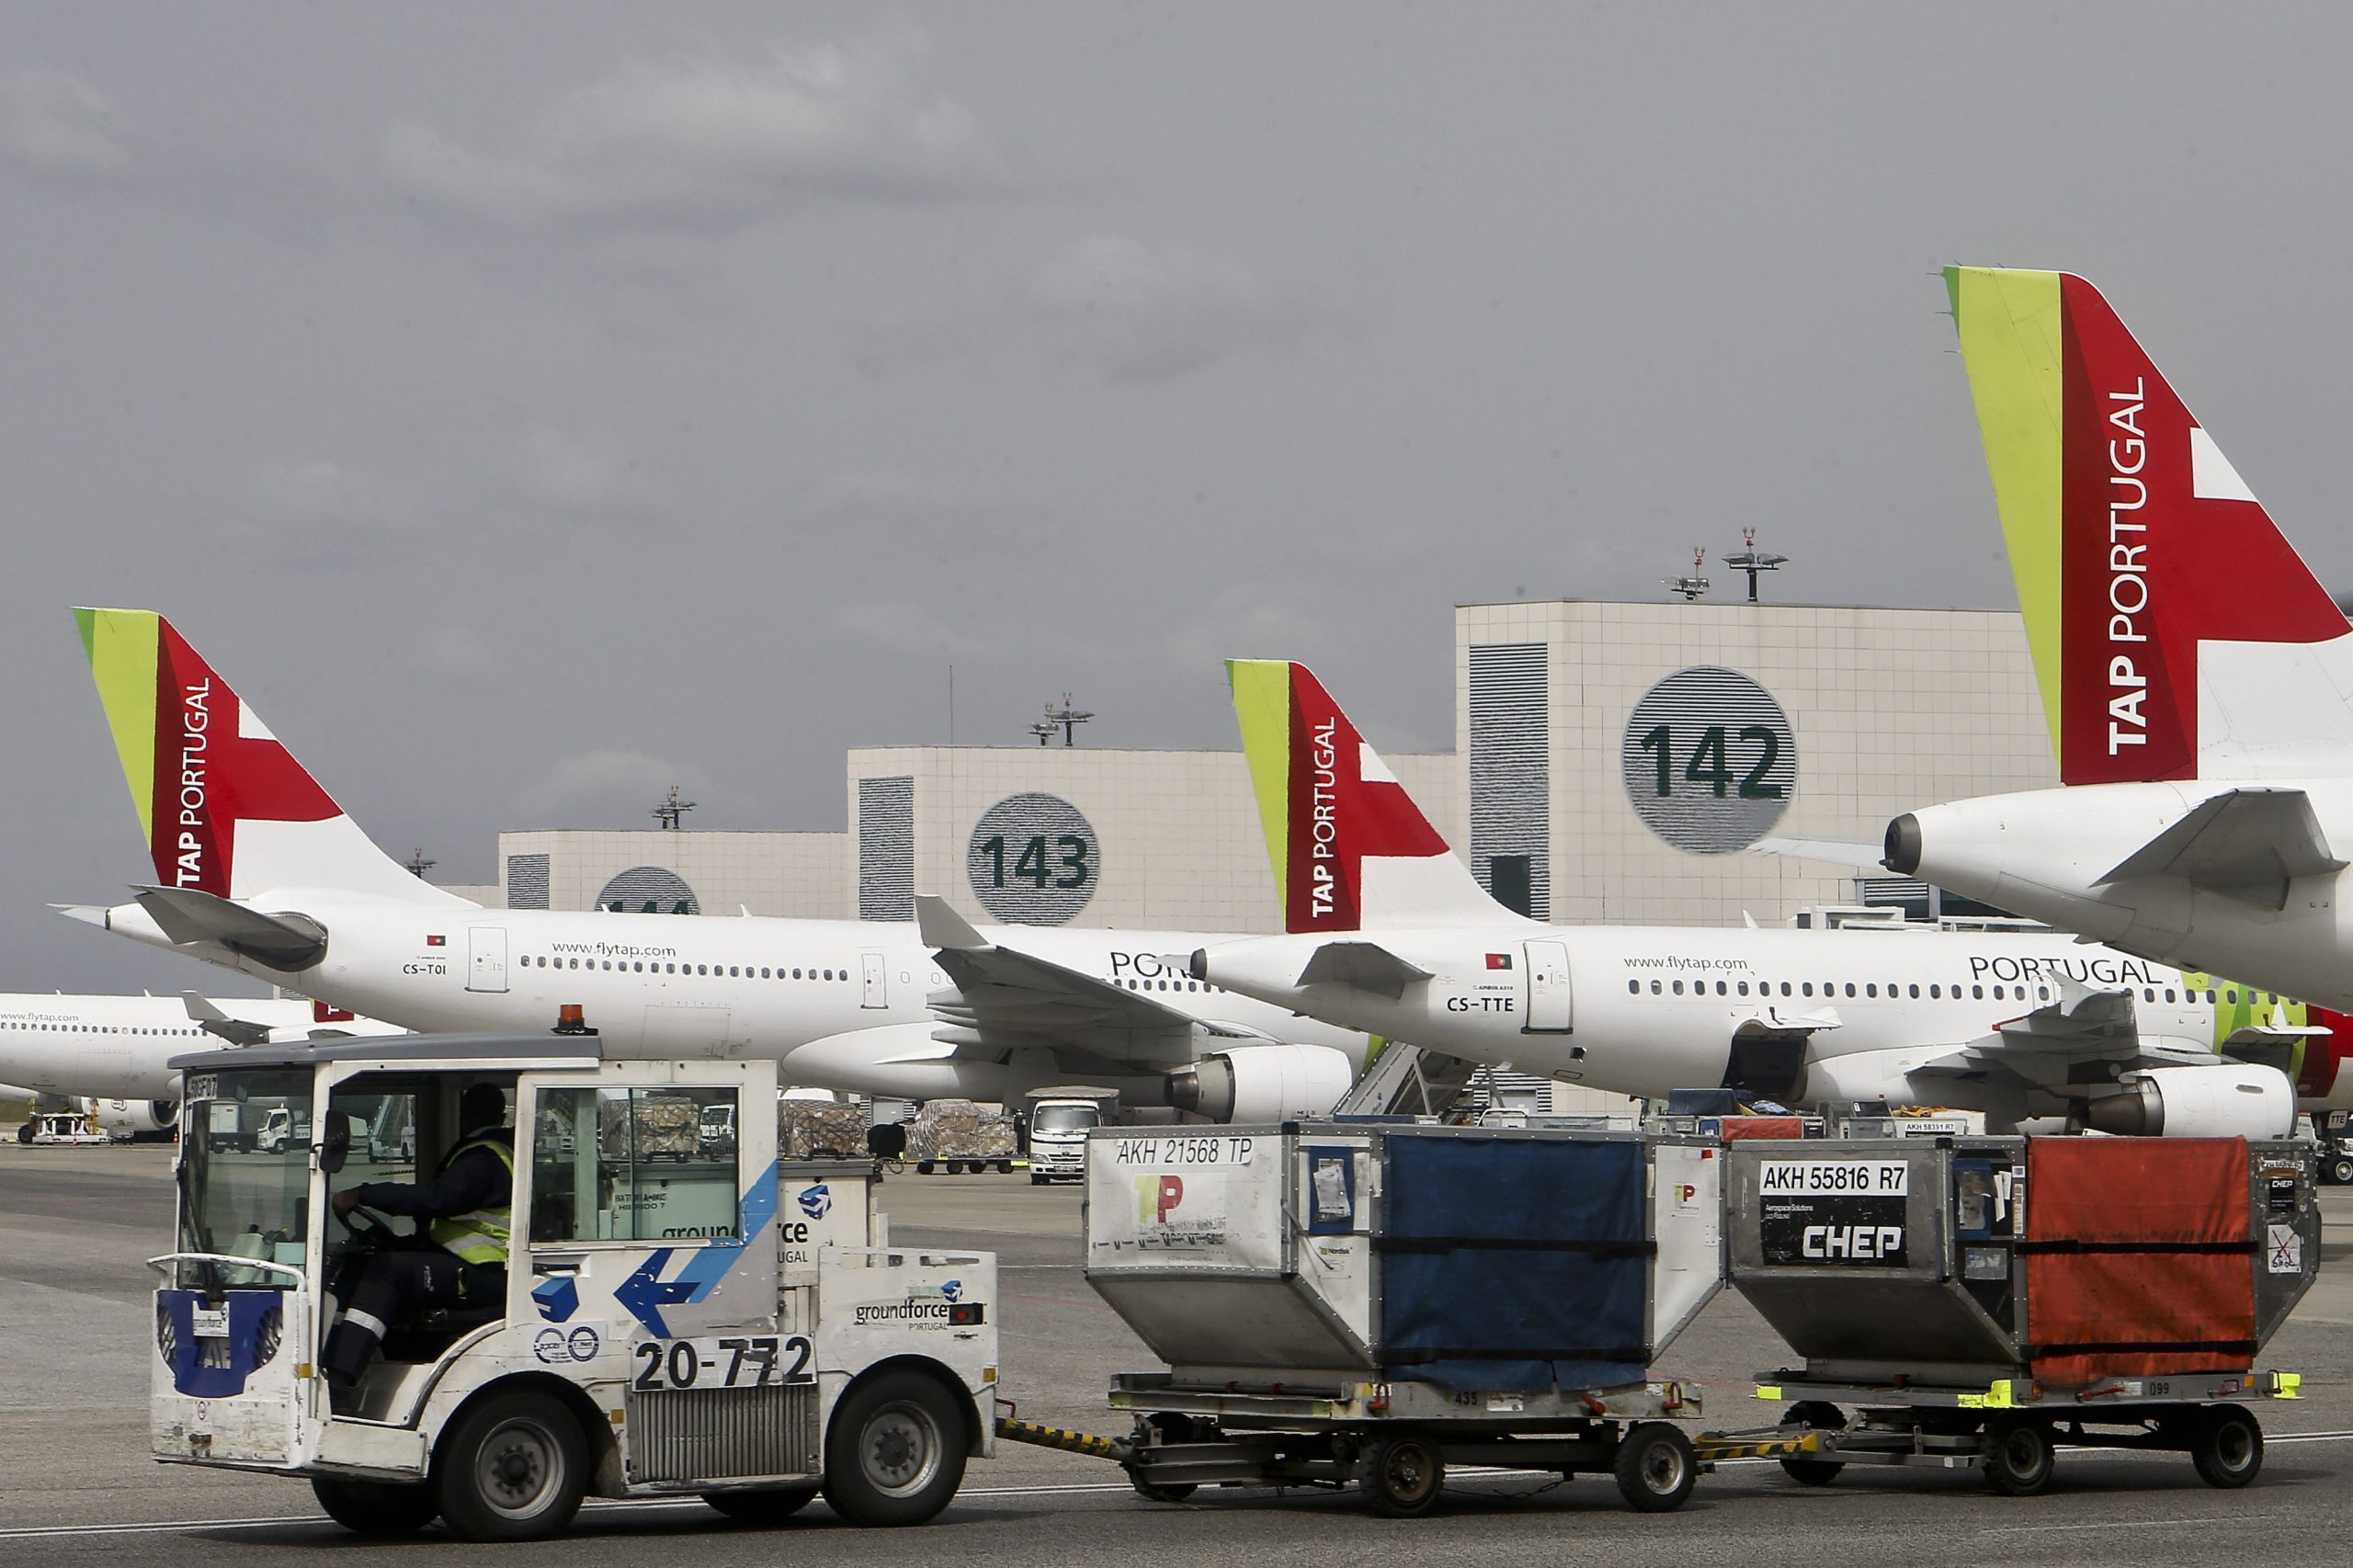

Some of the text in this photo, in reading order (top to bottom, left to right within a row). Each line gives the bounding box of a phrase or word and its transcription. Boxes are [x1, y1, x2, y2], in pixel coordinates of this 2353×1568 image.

[2109, 376, 2147, 755] TAP PORTUGAL
[1641, 725, 1782, 799] 142
[176, 677, 210, 887] TAP PORTUGAL
[1313, 717, 1336, 918] TAP PORTUGAL
[981, 835, 1088, 889] 143
[552, 941, 676, 958] www.flytap.com
[1623, 955, 1748, 972] www.flytap.com
[1970, 957, 2163, 984] PORTUGAL
[1448, 997, 1514, 1012] CS-TTE
[0, 1012, 79, 1023] www.flytap.com
[2331, 1115, 2346, 1124] TTE
[1117, 1138, 1253, 1164] AKH 21568 TP
[1763, 1166, 1905, 1190] AKH 55816 R7
[1802, 1225, 1902, 1258] CHEP
[777, 1251, 809, 1264] UGAL
[857, 1300, 949, 1325] groundforce
[635, 1336, 813, 1391] 20-772
[1455, 1392, 1477, 1405] 435
[2150, 1382, 2169, 1395] 099
